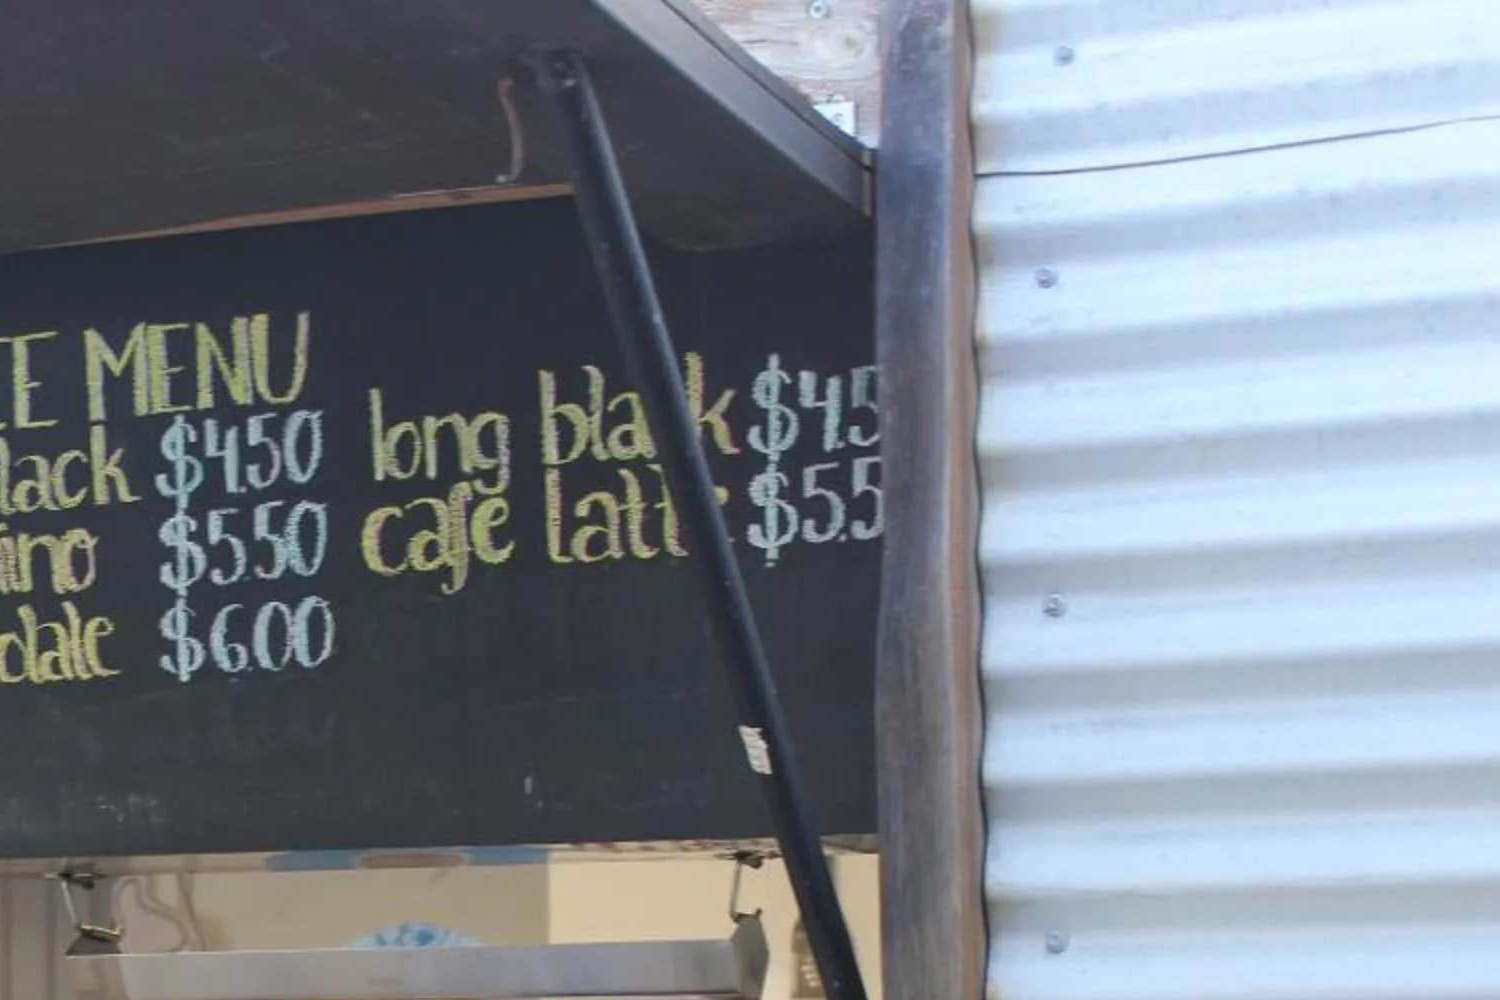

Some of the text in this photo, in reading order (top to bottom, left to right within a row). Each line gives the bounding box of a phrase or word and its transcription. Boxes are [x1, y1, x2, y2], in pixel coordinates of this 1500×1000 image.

[84, 313, 309, 422] MENU
[155, 410, 323, 508] $4.50
[369, 352, 882, 496] long blak $4.5
[159, 500, 328, 595] $5.50
[362, 461, 885, 595] cafe latt $5.5
[160, 596, 336, 682] $6.00
